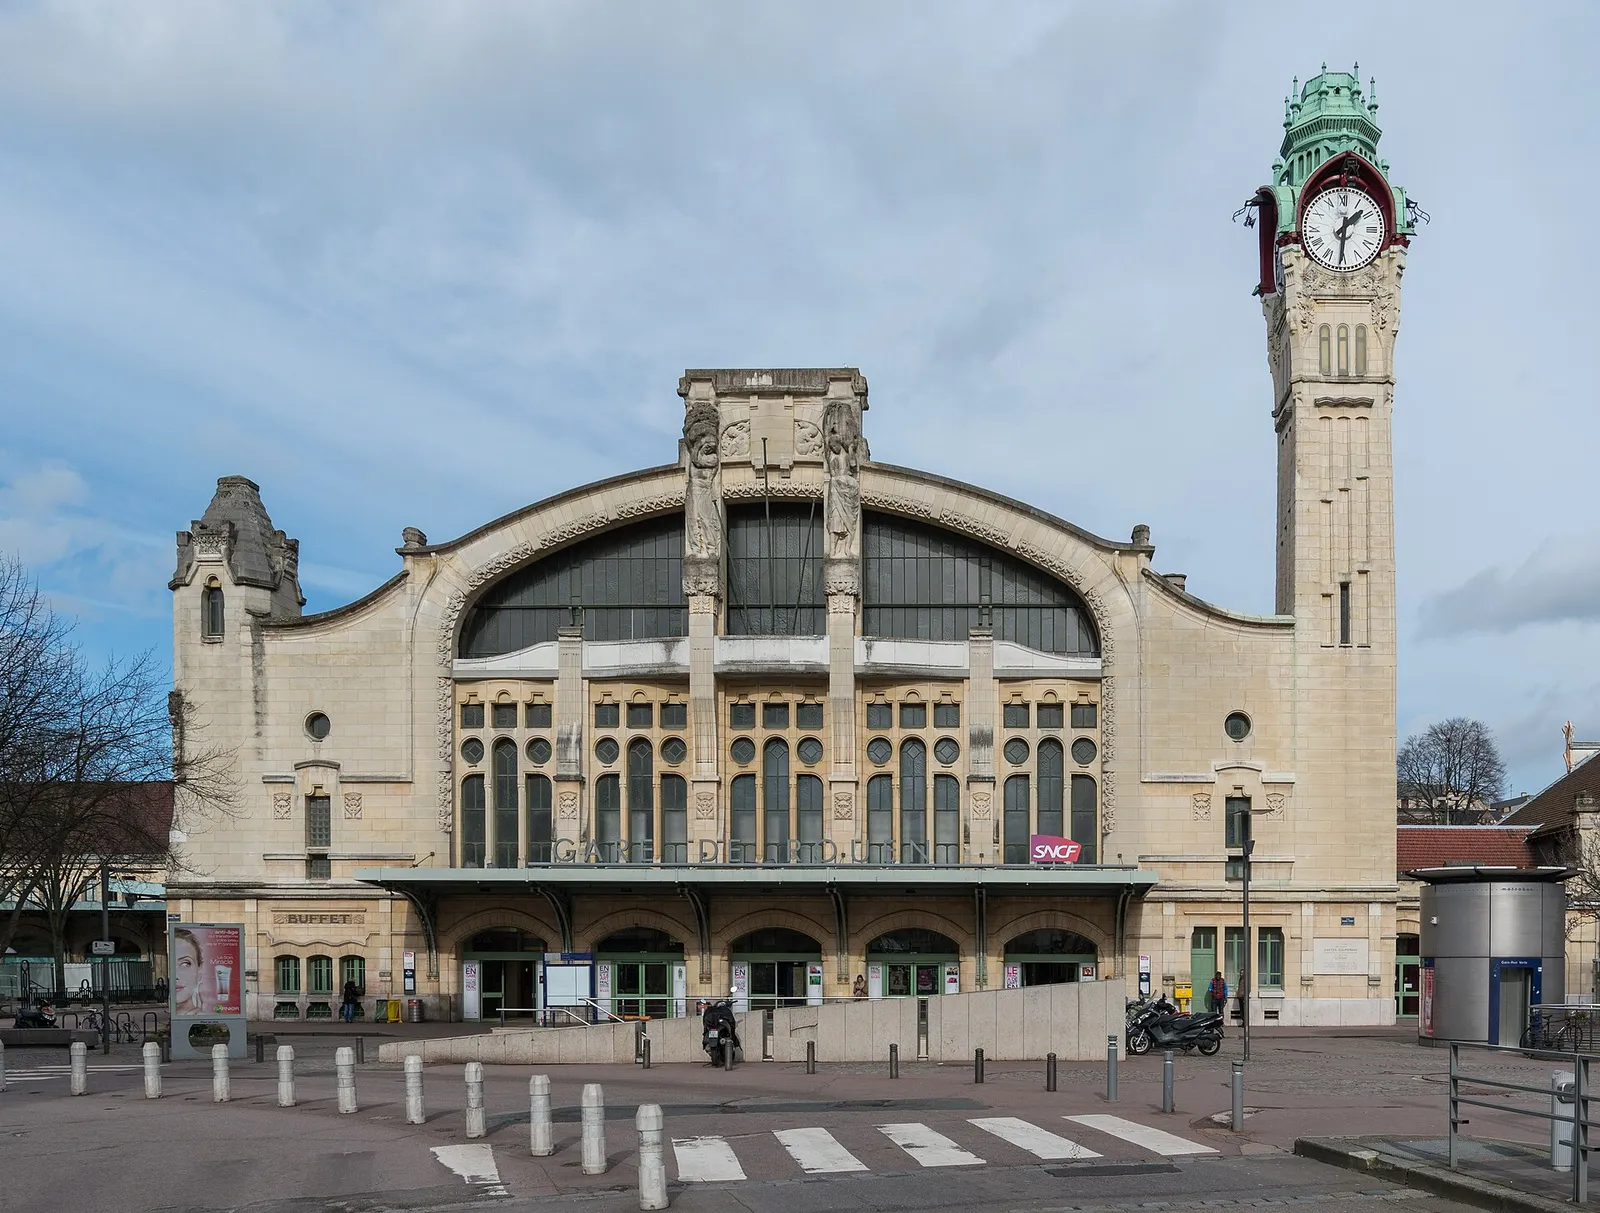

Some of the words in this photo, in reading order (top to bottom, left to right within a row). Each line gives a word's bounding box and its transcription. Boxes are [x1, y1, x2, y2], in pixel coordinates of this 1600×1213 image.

[552, 838, 653, 863] GARE
[700, 838, 742, 862] DE
[787, 838, 930, 862] ROUEN
[1033, 844, 1079, 859] SNCF
[287, 914, 350, 924] BUFFET
[1007, 966, 1018, 974] LE
